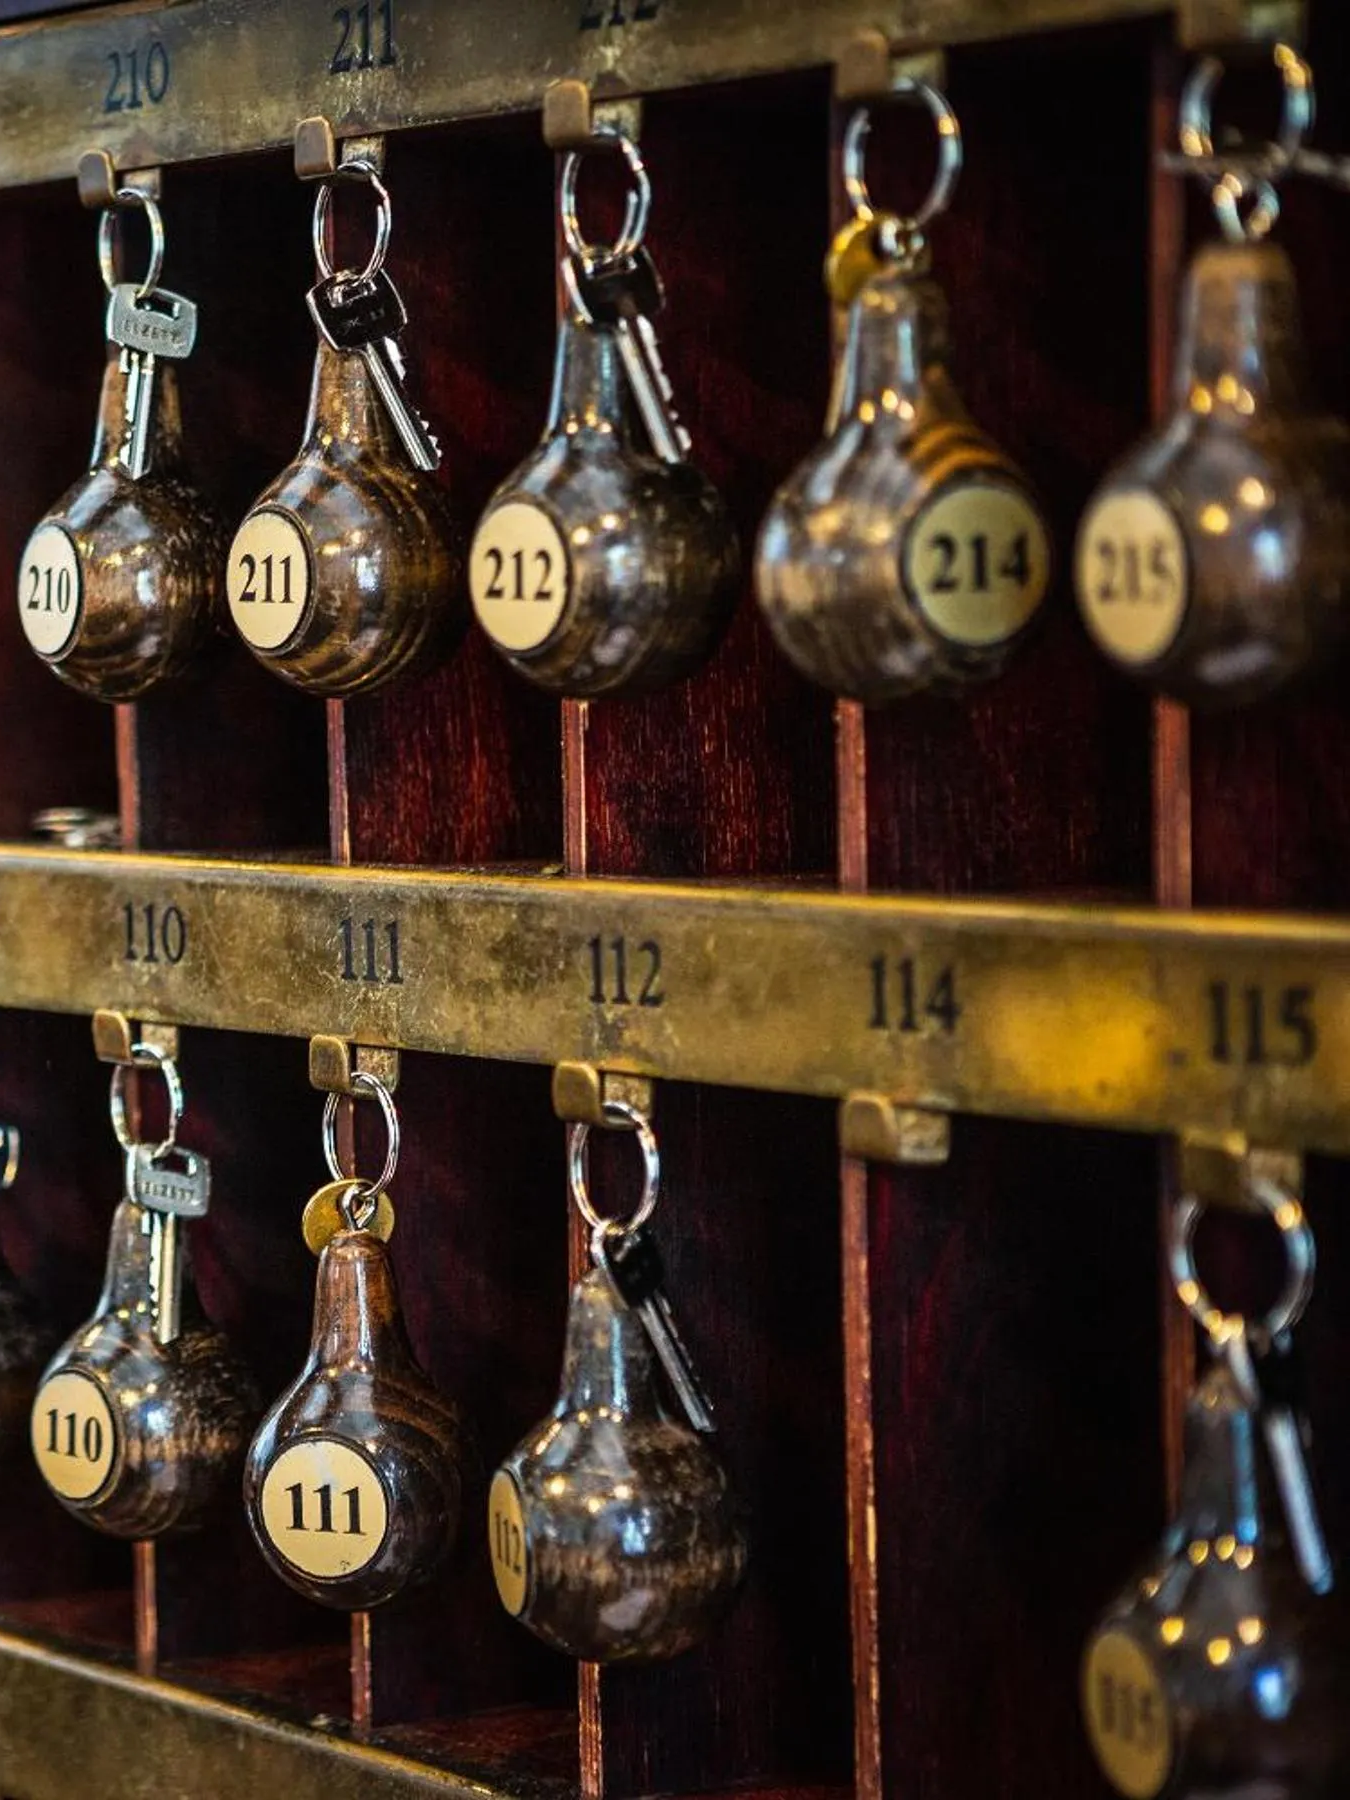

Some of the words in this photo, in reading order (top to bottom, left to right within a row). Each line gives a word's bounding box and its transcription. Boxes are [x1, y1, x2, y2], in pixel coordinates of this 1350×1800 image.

[330, 0, 396, 75] 211
[104, 40, 170, 114] 210
[27, 564, 71, 614] 210
[238, 553, 295, 604] 211
[484, 547, 555, 602] 212
[928, 532, 1031, 594] 214
[1096, 538, 1177, 603] 215
[121, 900, 188, 967] 110
[339, 916, 404, 985] 111
[587, 933, 666, 1008] 112
[869, 951, 961, 1034] 114
[1206, 979, 1320, 1068] 115
[45, 1408, 102, 1463] 110
[285, 1482, 367, 1536] 111
[495, 1511, 522, 1577] 112
